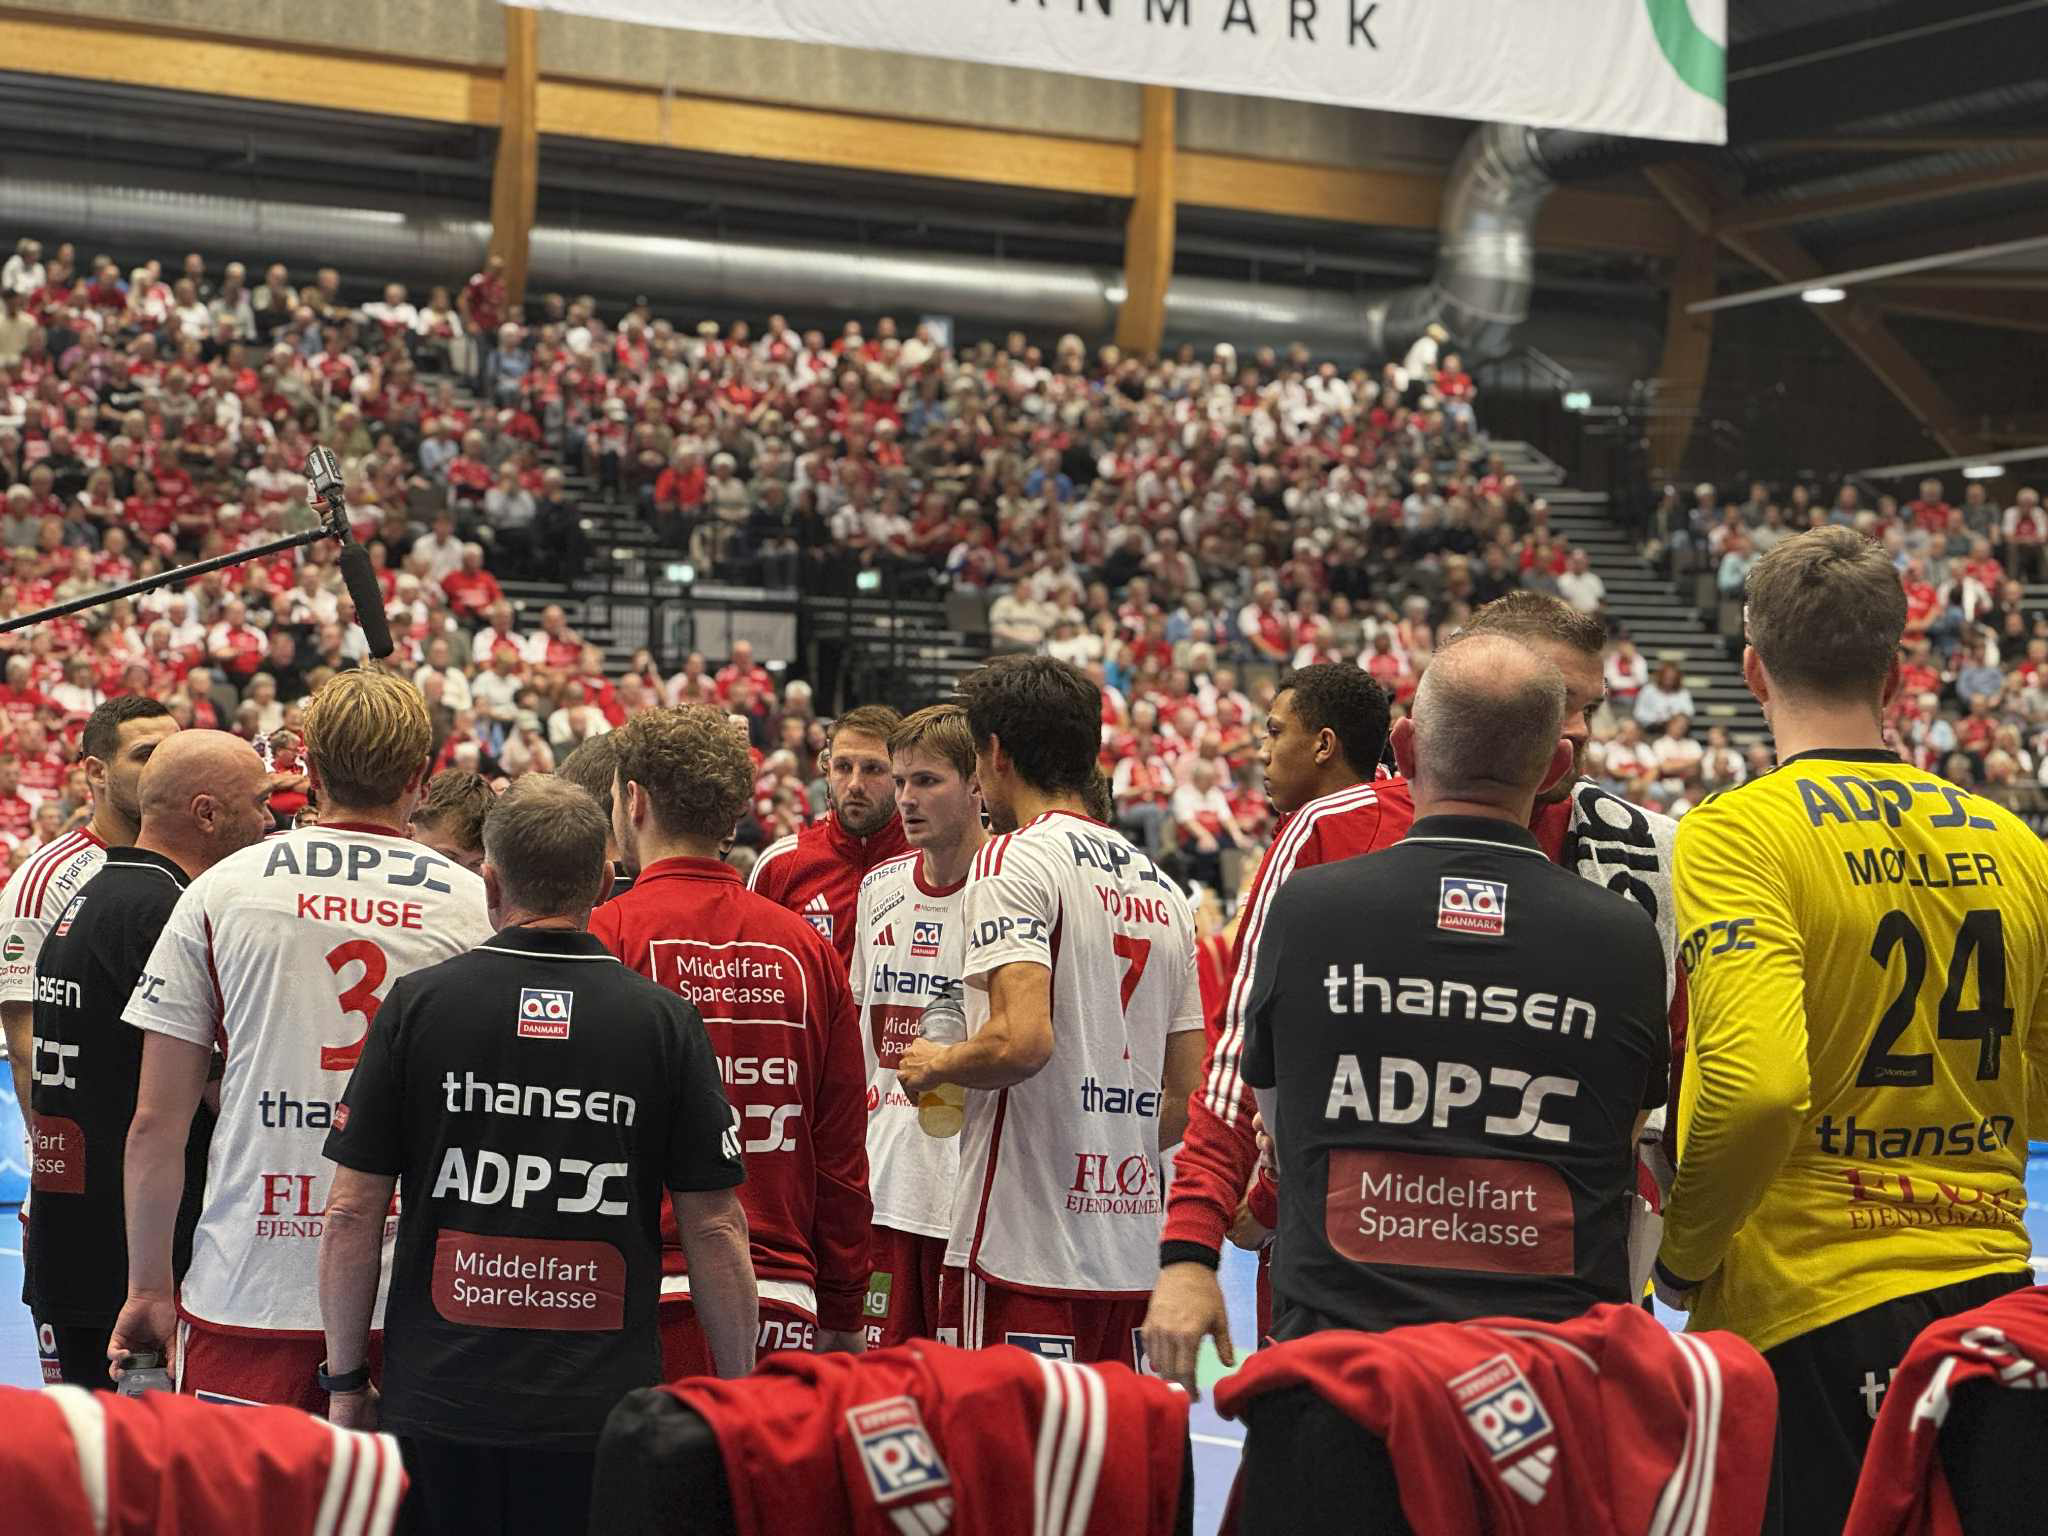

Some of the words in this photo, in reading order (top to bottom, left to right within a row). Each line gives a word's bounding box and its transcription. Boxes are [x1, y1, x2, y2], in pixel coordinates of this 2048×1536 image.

[297, 893, 424, 930] KRUSE
[1445, 915, 1498, 930] DANMARK
[320, 939, 388, 1071] 3
[1113, 932, 1151, 1060] 7
[1323, 963, 1597, 1040] thansen
[1856, 908, 2015, 1088] 24
[523, 1024, 565, 1034] DANMARK
[442, 1071, 636, 1127] thansen
[1360, 1170, 1538, 1212] Middelfart
[1358, 1207, 1539, 1248] Sparekasse
[454, 1249, 599, 1282] Middelfart
[452, 1278, 597, 1309] Sparekasse
